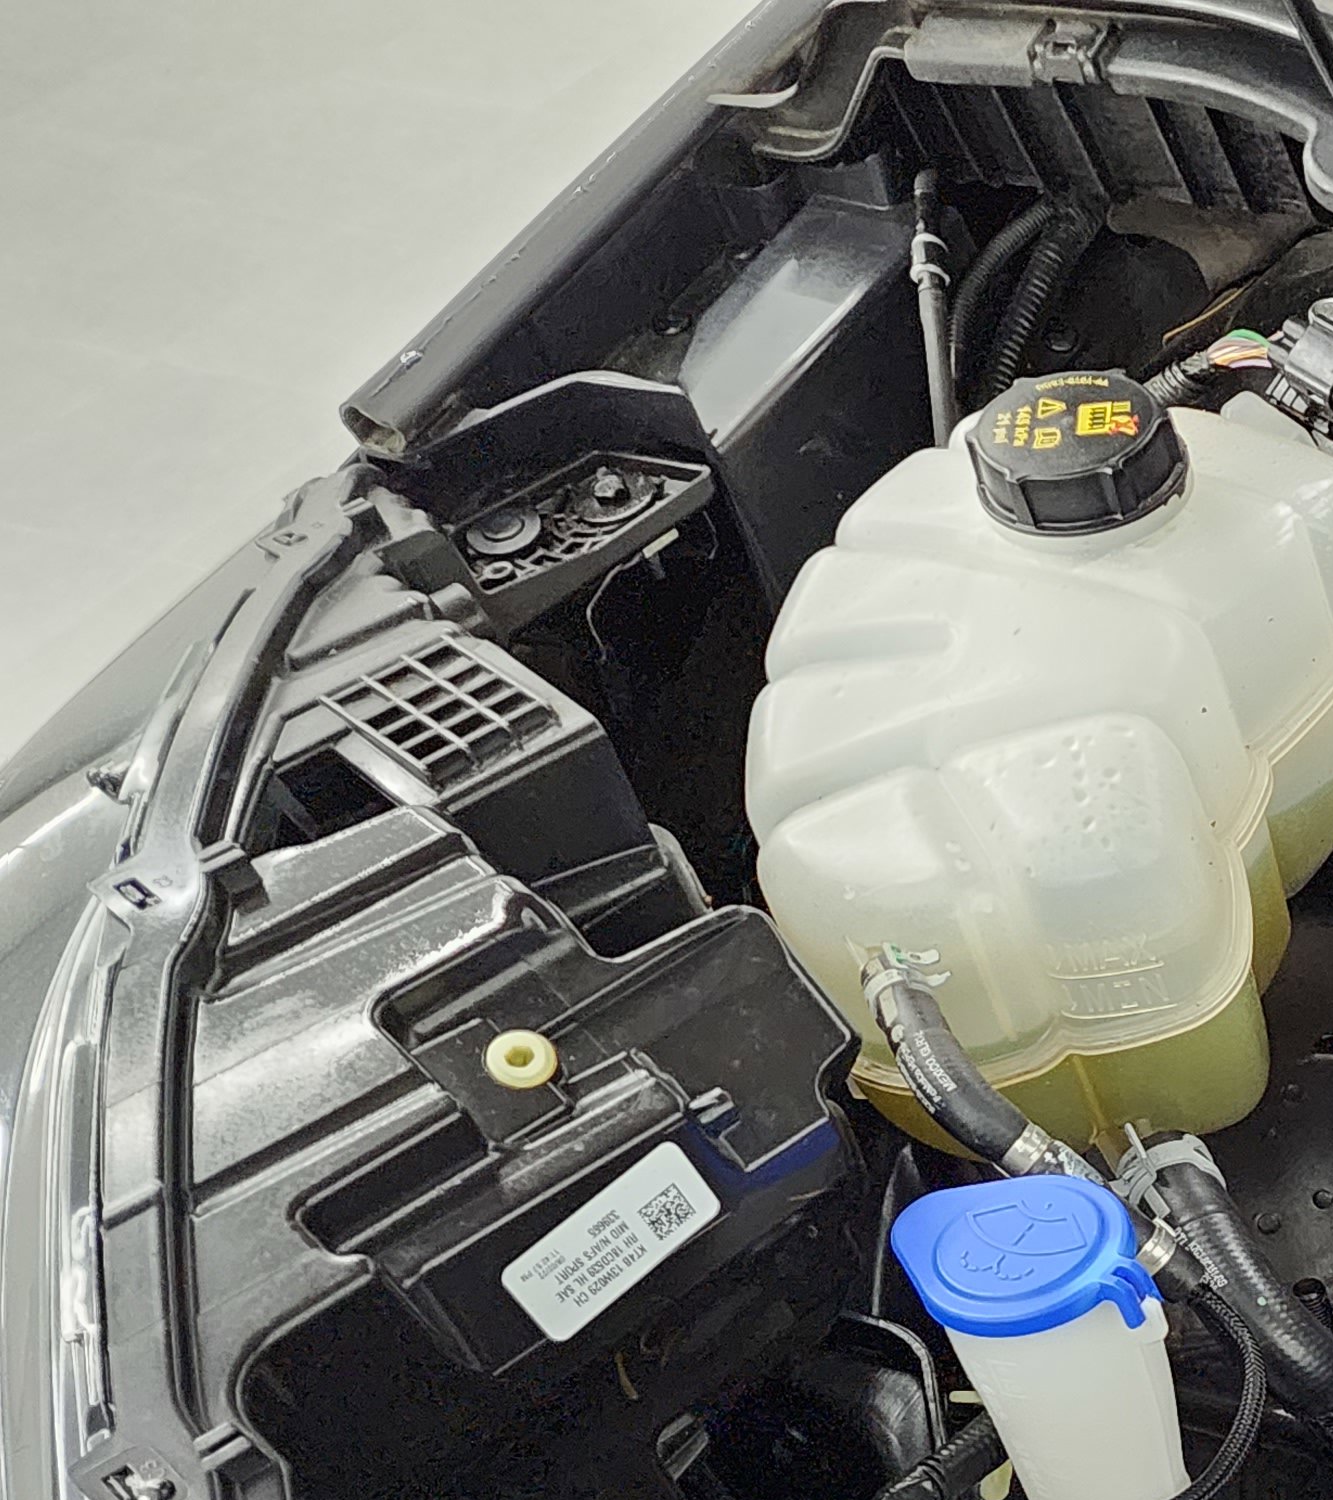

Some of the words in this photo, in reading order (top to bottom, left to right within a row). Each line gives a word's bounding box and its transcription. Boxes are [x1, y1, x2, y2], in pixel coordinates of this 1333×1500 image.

[621, 1231, 639, 1249] RH
[553, 1256, 585, 1286] SPORT
[554, 1283, 576, 1303] SAE
[571, 1290, 590, 1308] CH
